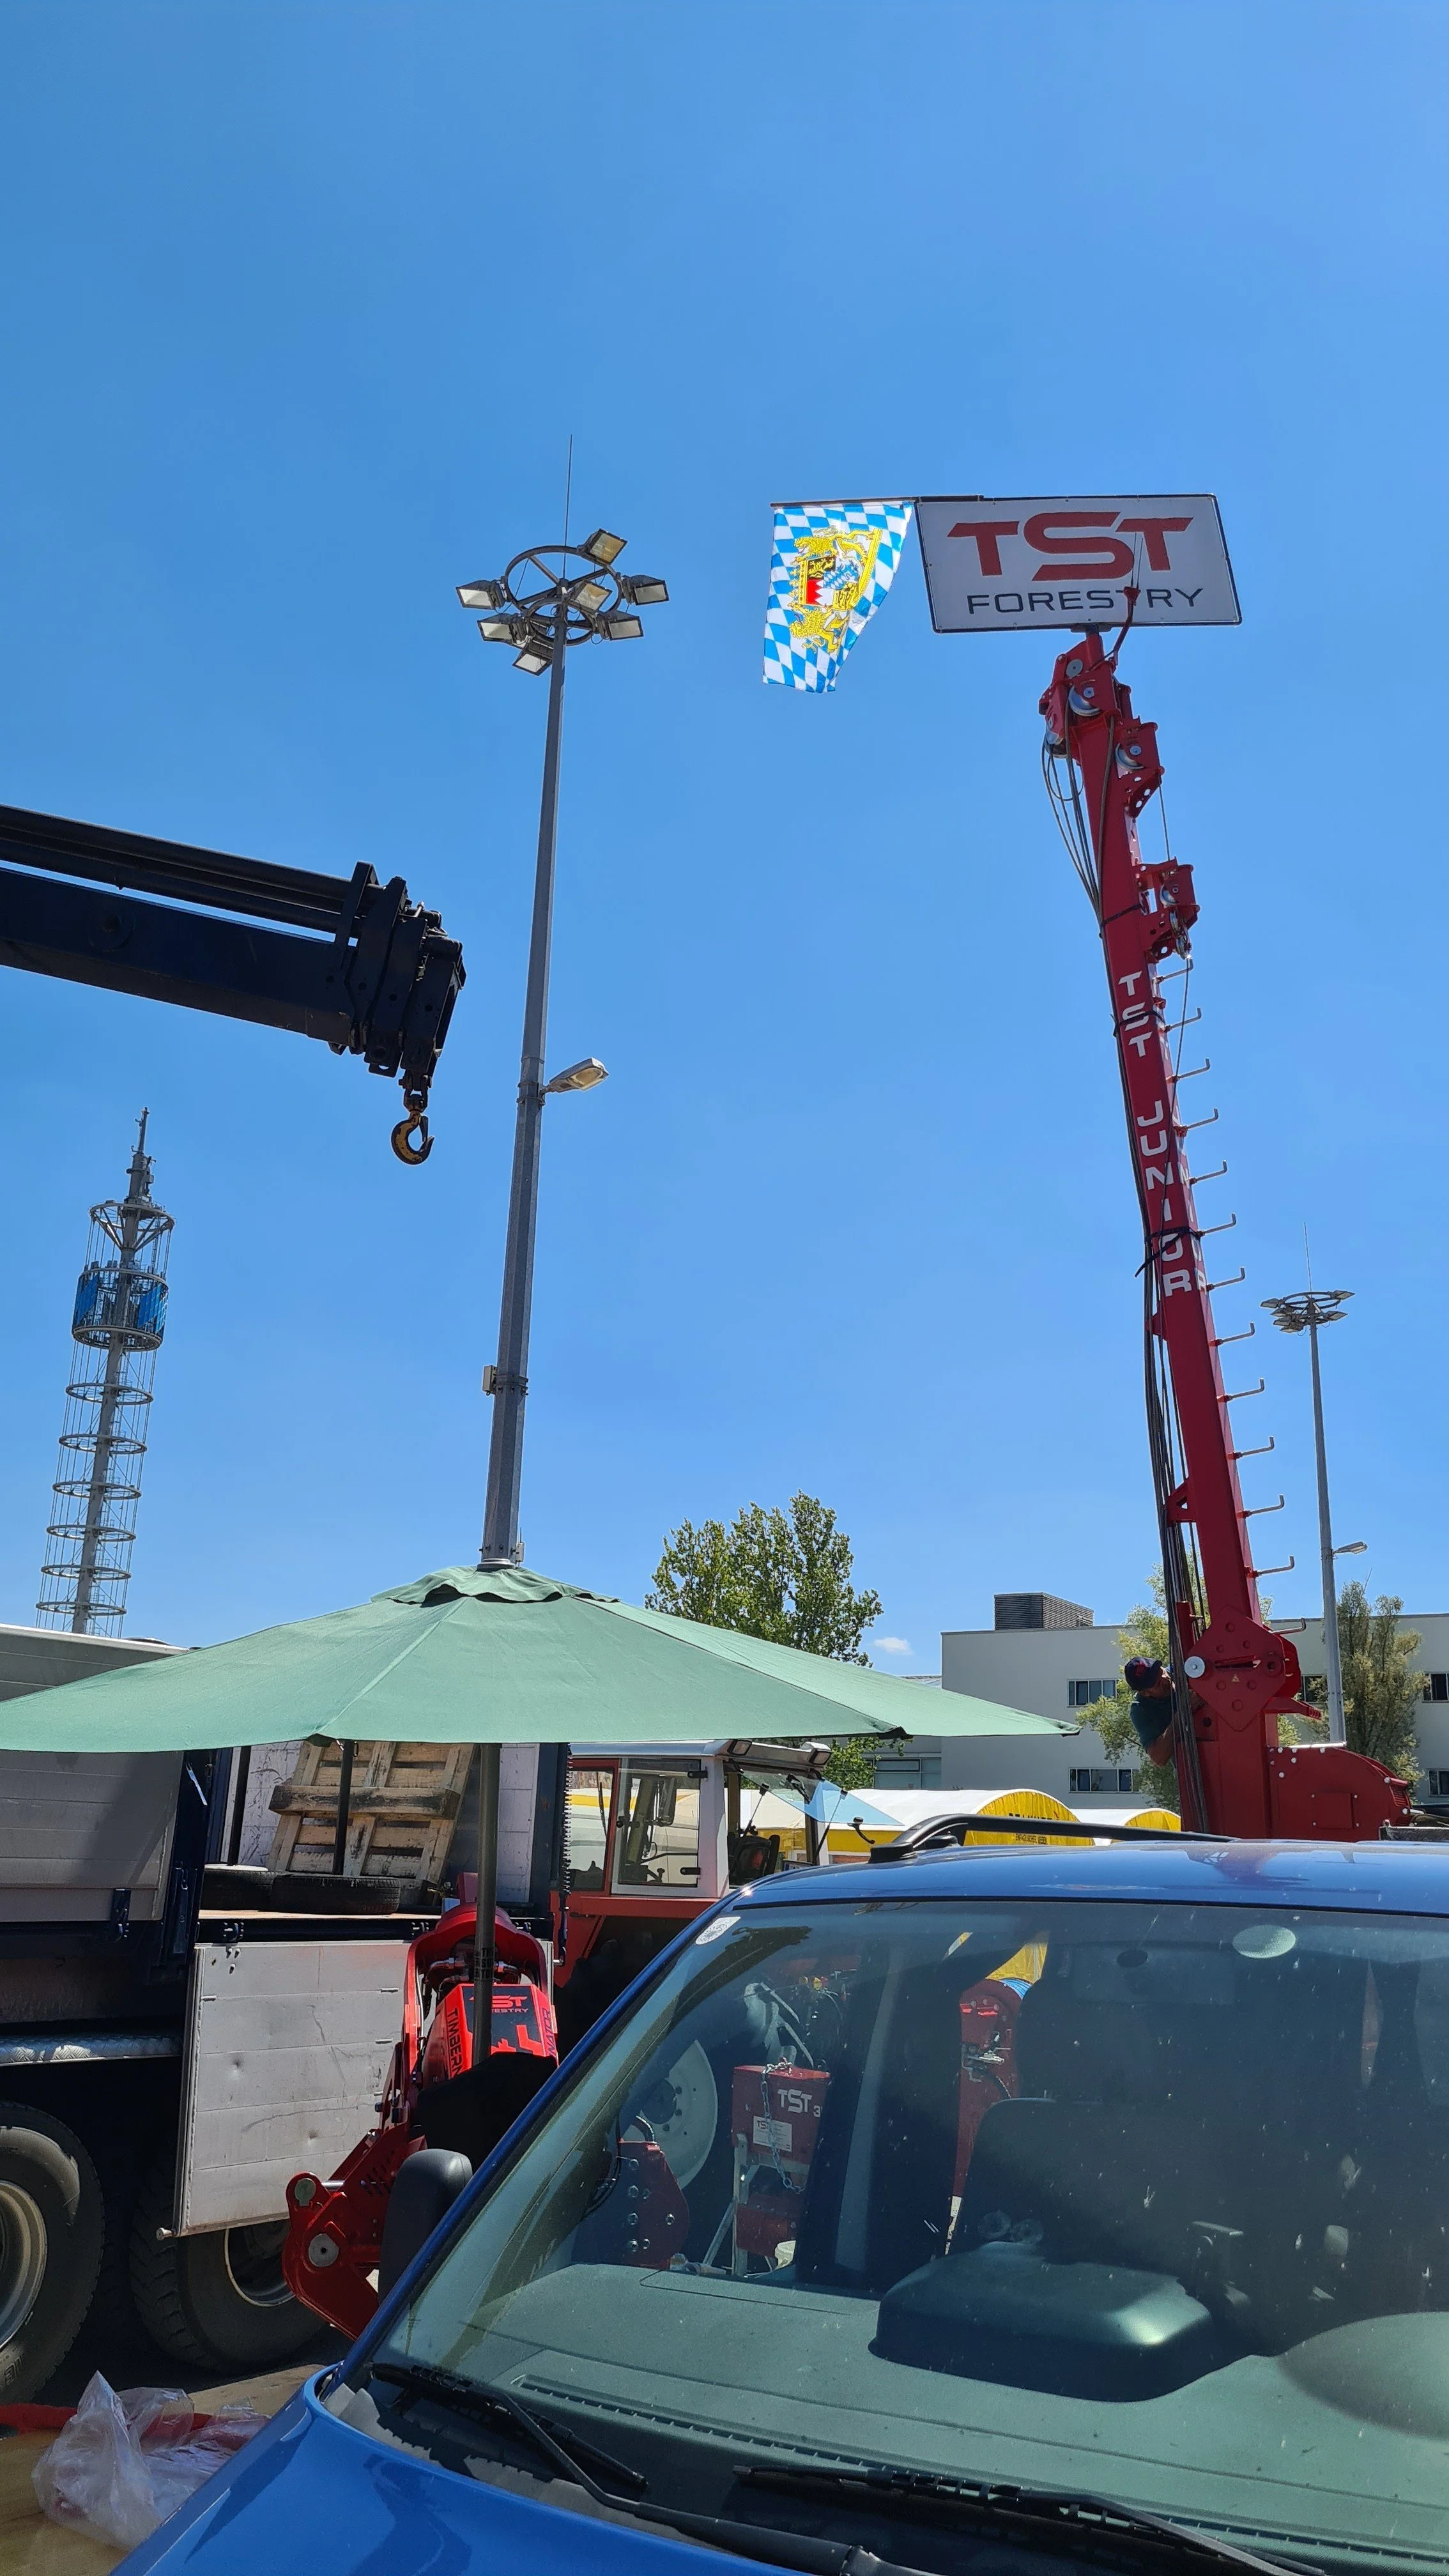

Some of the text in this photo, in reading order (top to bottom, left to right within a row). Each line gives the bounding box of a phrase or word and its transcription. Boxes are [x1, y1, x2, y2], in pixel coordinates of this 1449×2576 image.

[947, 511, 1194, 582] TST
[1118, 970, 1192, 1298] TST JUNIOR
[469, 1995, 528, 2008] ST
[777, 2089, 813, 2113] TST
[813, 2105, 822, 2117] 3
[756, 2120, 769, 2129] TS
